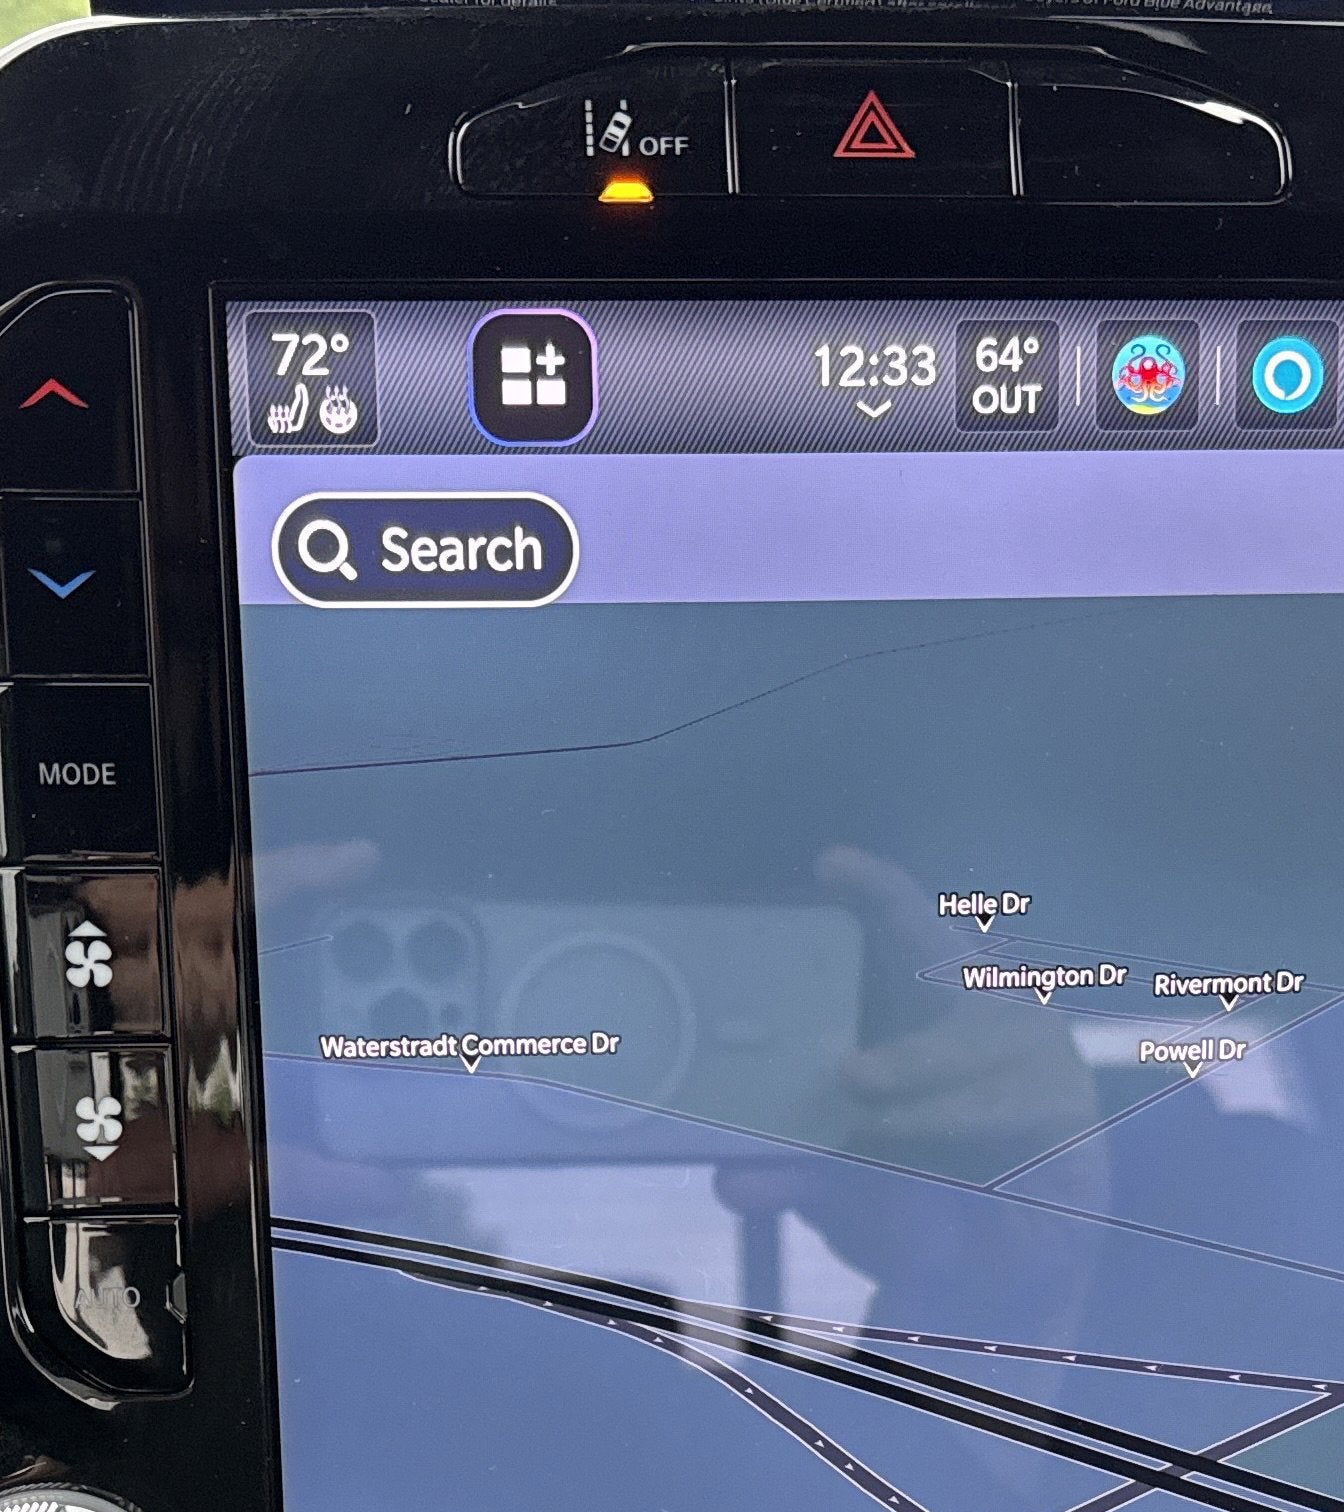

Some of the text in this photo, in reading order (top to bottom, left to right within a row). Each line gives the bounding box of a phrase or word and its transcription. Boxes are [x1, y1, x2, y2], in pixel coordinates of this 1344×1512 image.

[638, 136, 689, 156] OFF
[272, 333, 349, 375] 72°
[813, 343, 937, 388] 12:33
[975, 336, 1039, 373] 64°
[973, 383, 1042, 415] OUT
[381, 526, 542, 572] Search
[38, 763, 116, 786] MODE
[939, 893, 1030, 915] Helle Dr
[963, 965, 1127, 991] Wilmington Dr
[1154, 971, 1305, 997] Rivermont Dr
[320, 1032, 620, 1059] Waterstradt Commerce Dr
[1140, 1039, 1247, 1063] Powell Dr
